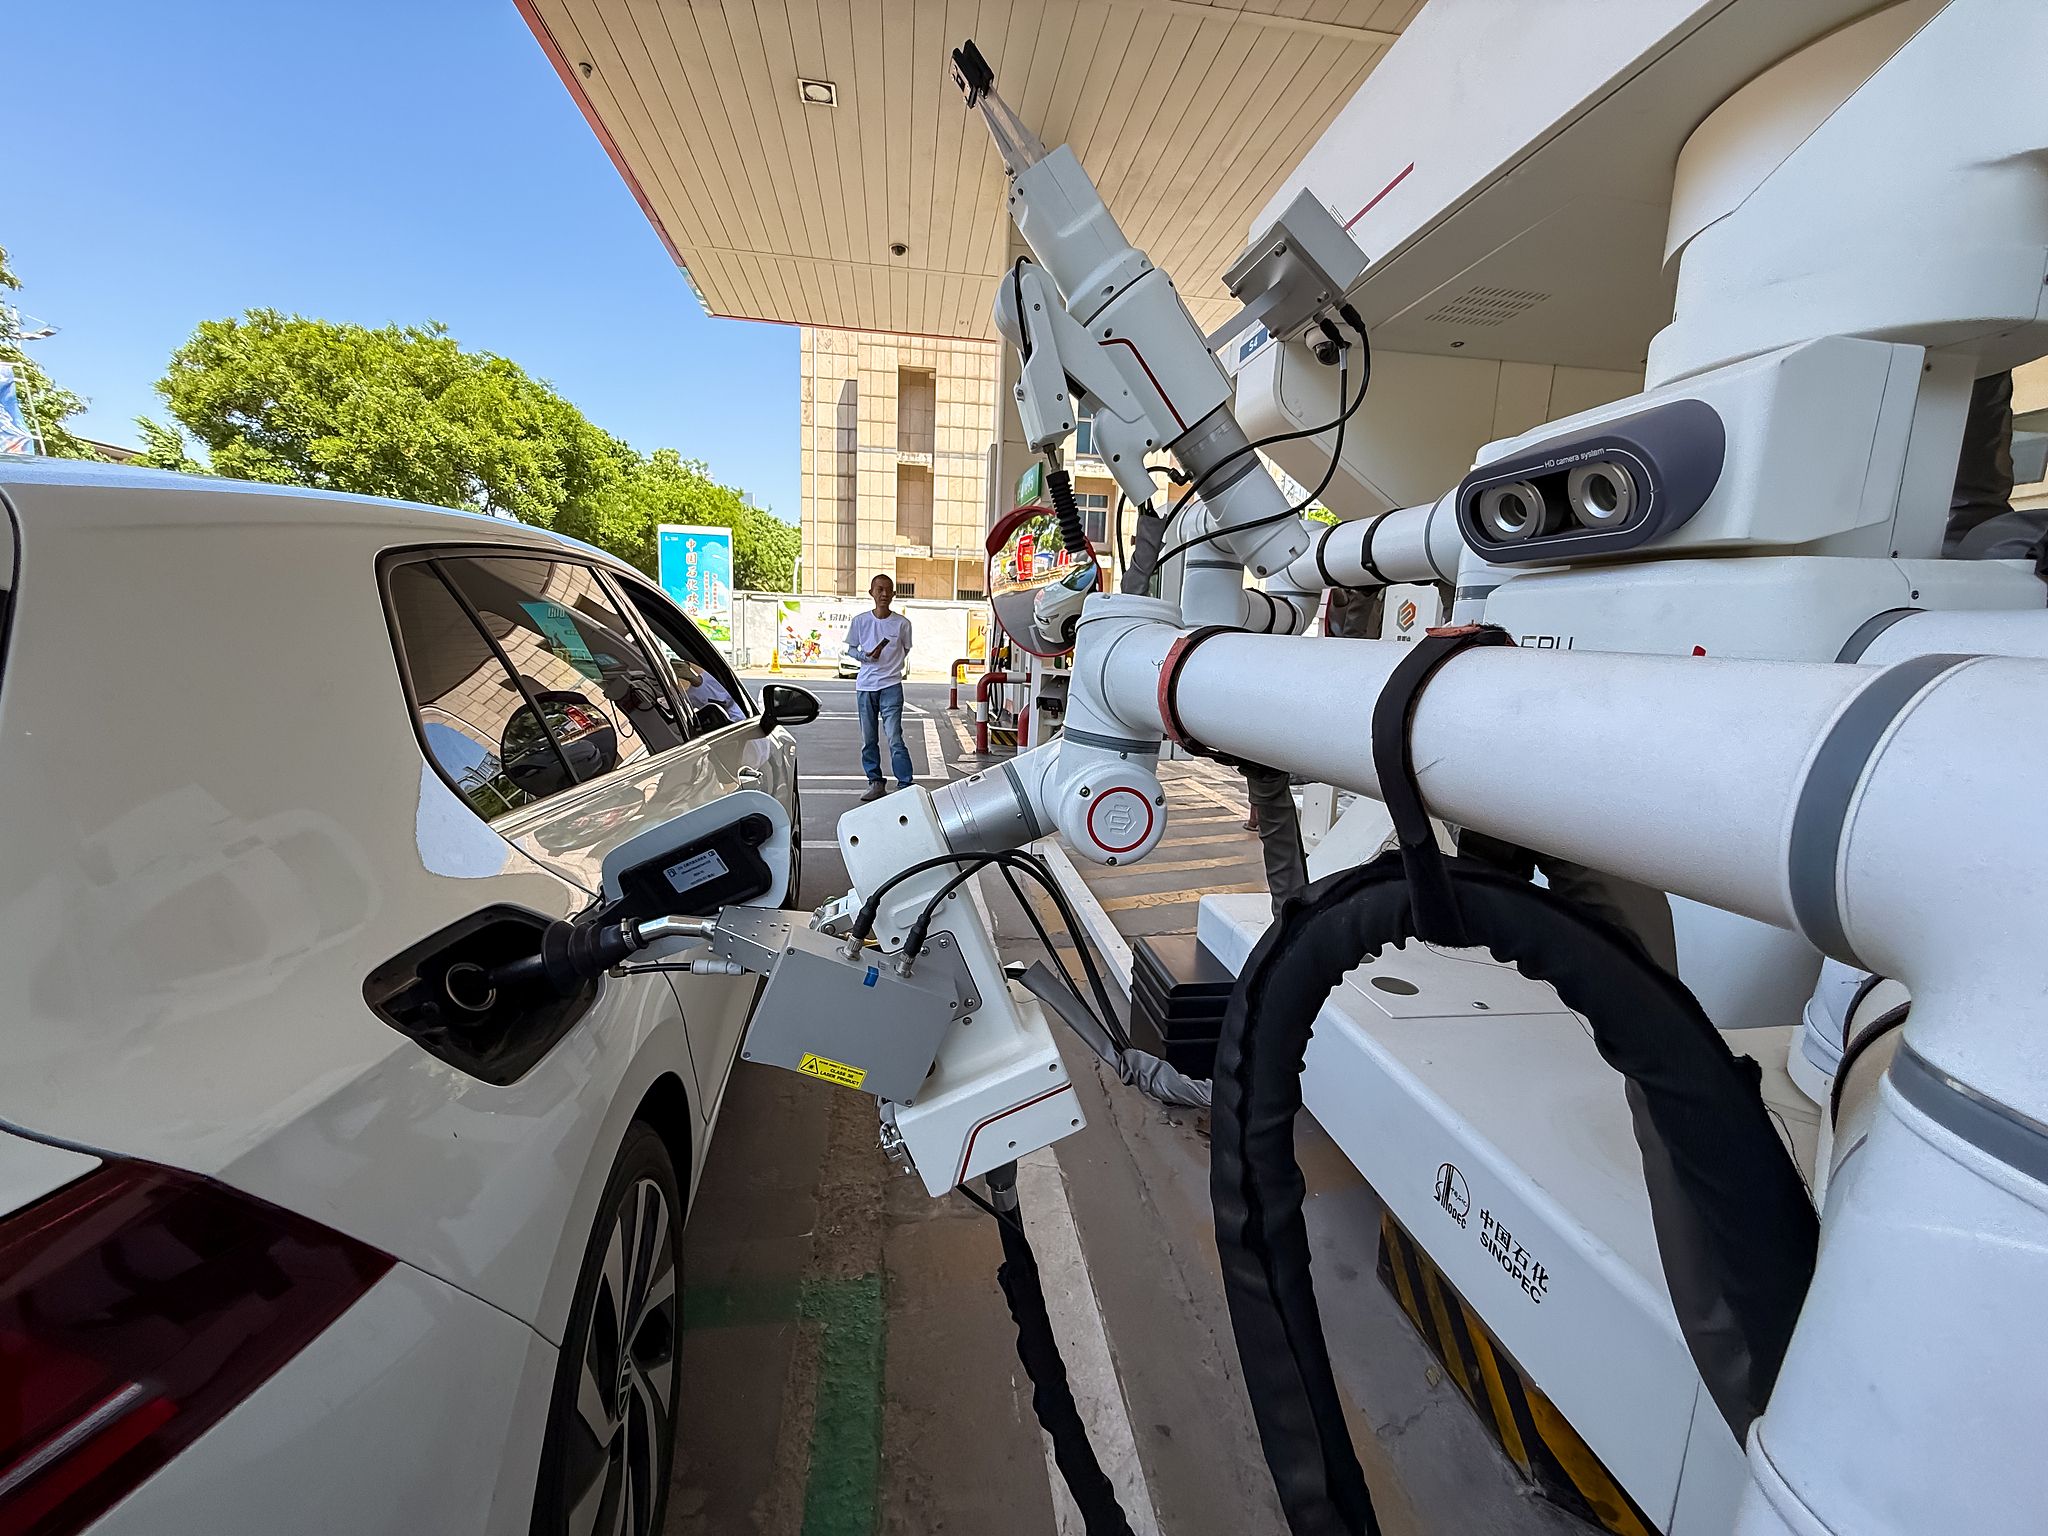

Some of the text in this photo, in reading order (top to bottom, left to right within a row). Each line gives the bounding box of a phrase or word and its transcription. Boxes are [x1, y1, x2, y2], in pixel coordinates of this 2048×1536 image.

[1544, 448, 1605, 468] HD camera system
[837, 1075, 859, 1085] PRODUCT
[1480, 1209, 1549, 1293] 中国石化
[1480, 1231, 1541, 1304] SINOPEC
